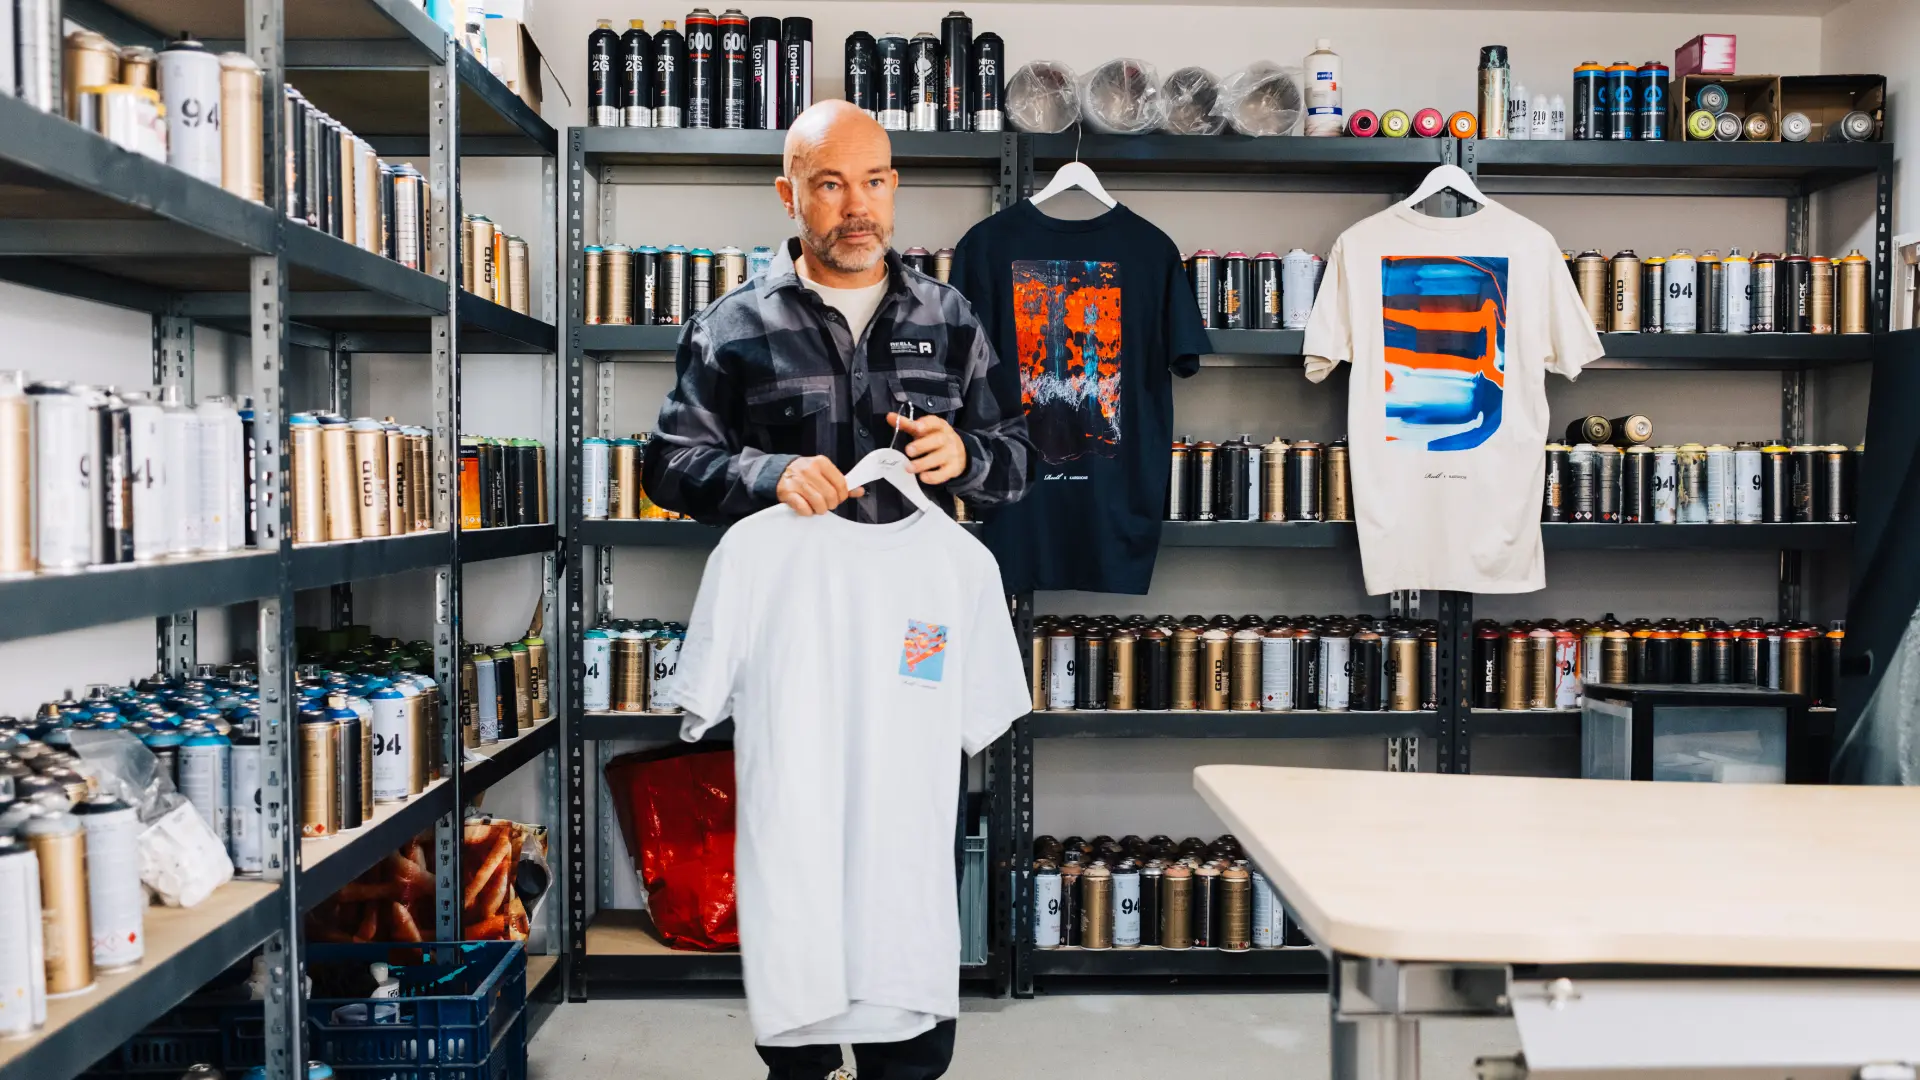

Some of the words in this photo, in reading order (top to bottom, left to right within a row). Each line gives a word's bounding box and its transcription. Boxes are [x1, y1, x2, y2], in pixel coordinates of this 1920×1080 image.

[688, 31, 713, 50] 600
[723, 32, 747, 51] 600
[593, 61, 610, 72] 2G
[626, 61, 643, 72] 2G
[657, 61, 674, 72] 2G
[884, 65, 901, 75] 2G
[978, 65, 995, 76] 2G
[181, 98, 220, 131] 94
[1533, 110, 1546, 121] 210
[484, 246, 492, 283] GOLD
[1264, 279, 1272, 314] BLACK
[1616, 279, 1624, 312] GOLD
[1669, 282, 1693, 299] 94
[1744, 284, 1753, 300] 9
[362, 460, 373, 508] GOLD
[1752, 474, 1762, 491] 9
[583, 662, 600, 679] 4
[1066, 660, 1075, 677] 9
[1214, 659, 1222, 692] GOLD
[1308, 660, 1316, 694] BLACK
[1344, 660, 1352, 677] 9
[1485, 659, 1493, 693] BLACK
[531, 666, 539, 699] GOLD
[462, 689, 471, 726] GOLD
[373, 733, 402, 757] 94
[1048, 898, 1060, 916] 9
[1121, 897, 1140, 915] 94
